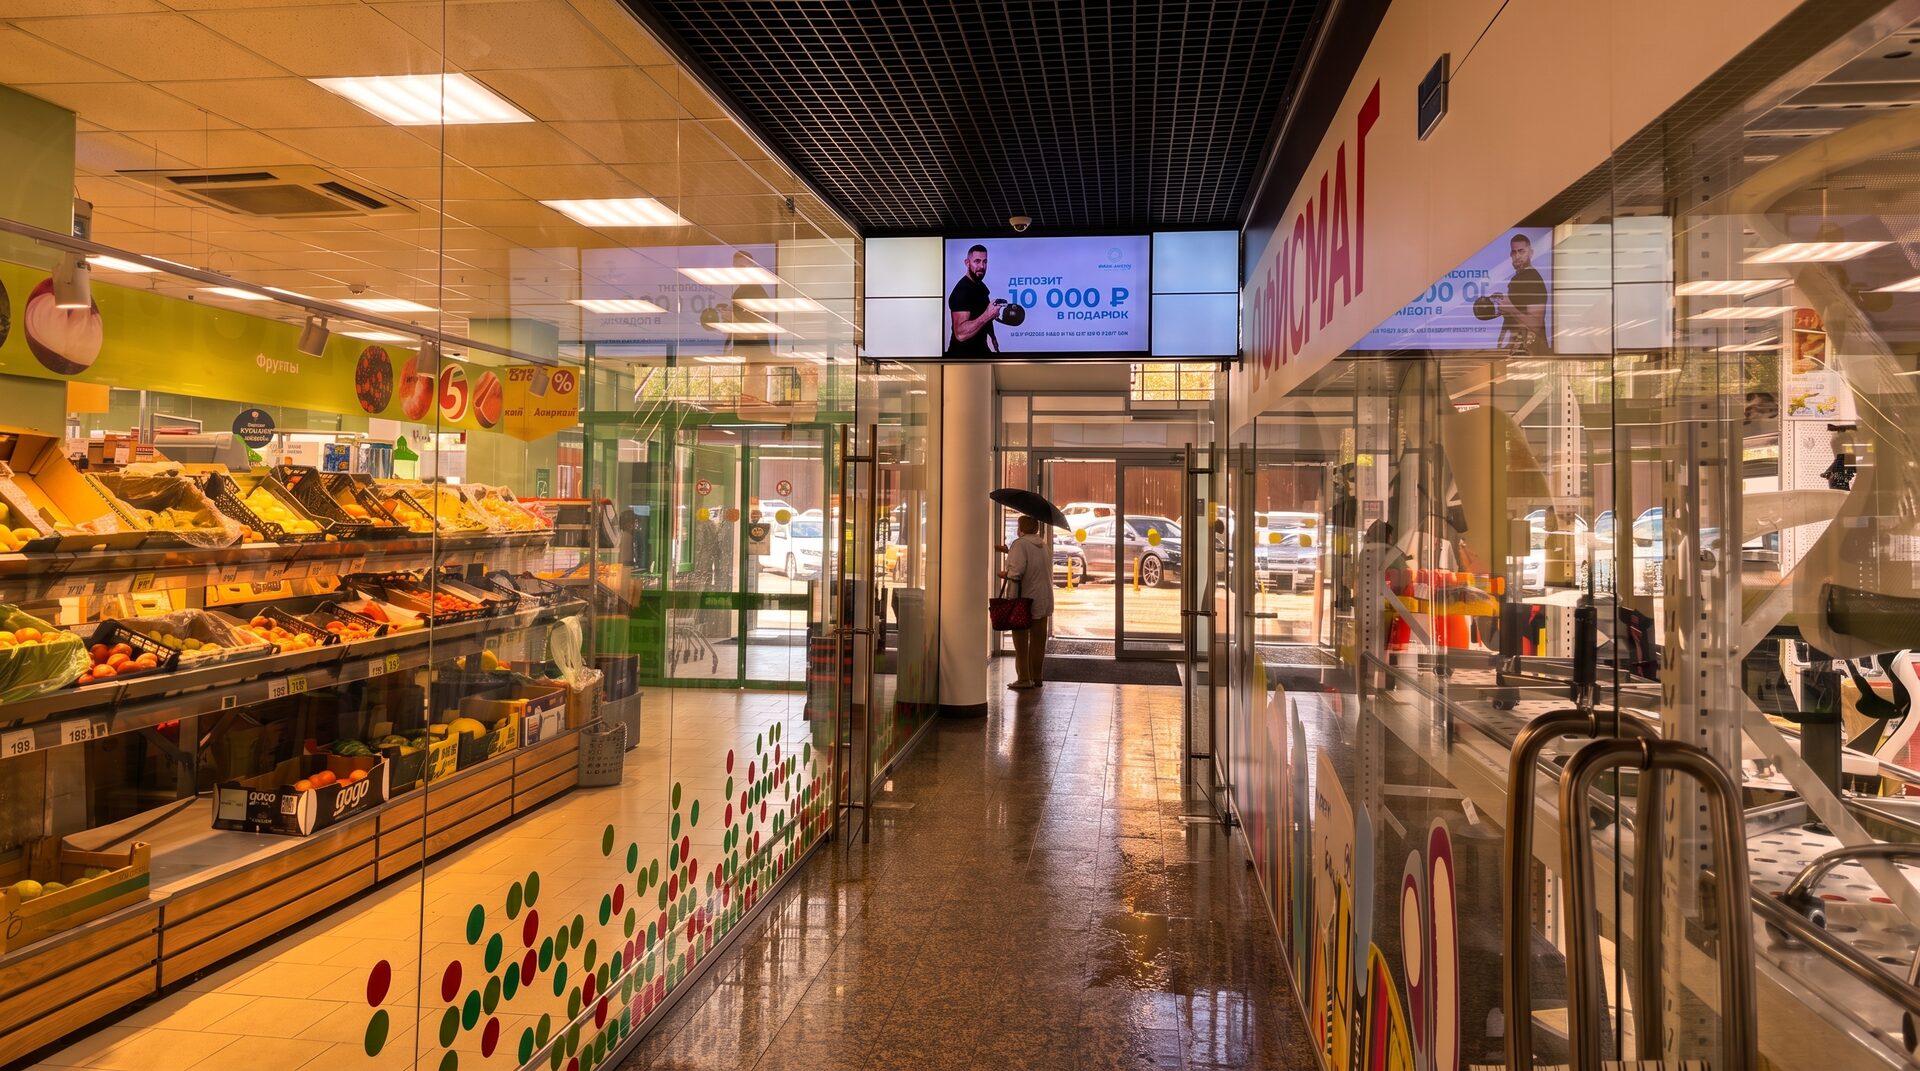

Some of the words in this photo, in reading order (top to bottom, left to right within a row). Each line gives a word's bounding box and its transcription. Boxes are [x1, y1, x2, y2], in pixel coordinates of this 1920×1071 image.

[1252, 77, 1380, 393] ОФИСМАГ
[1008, 277, 1063, 287] ДЕПОЗИТ
[1008, 288, 1037, 309] 10
[1046, 287, 1100, 308] 000
[1057, 311, 1065, 320] В
